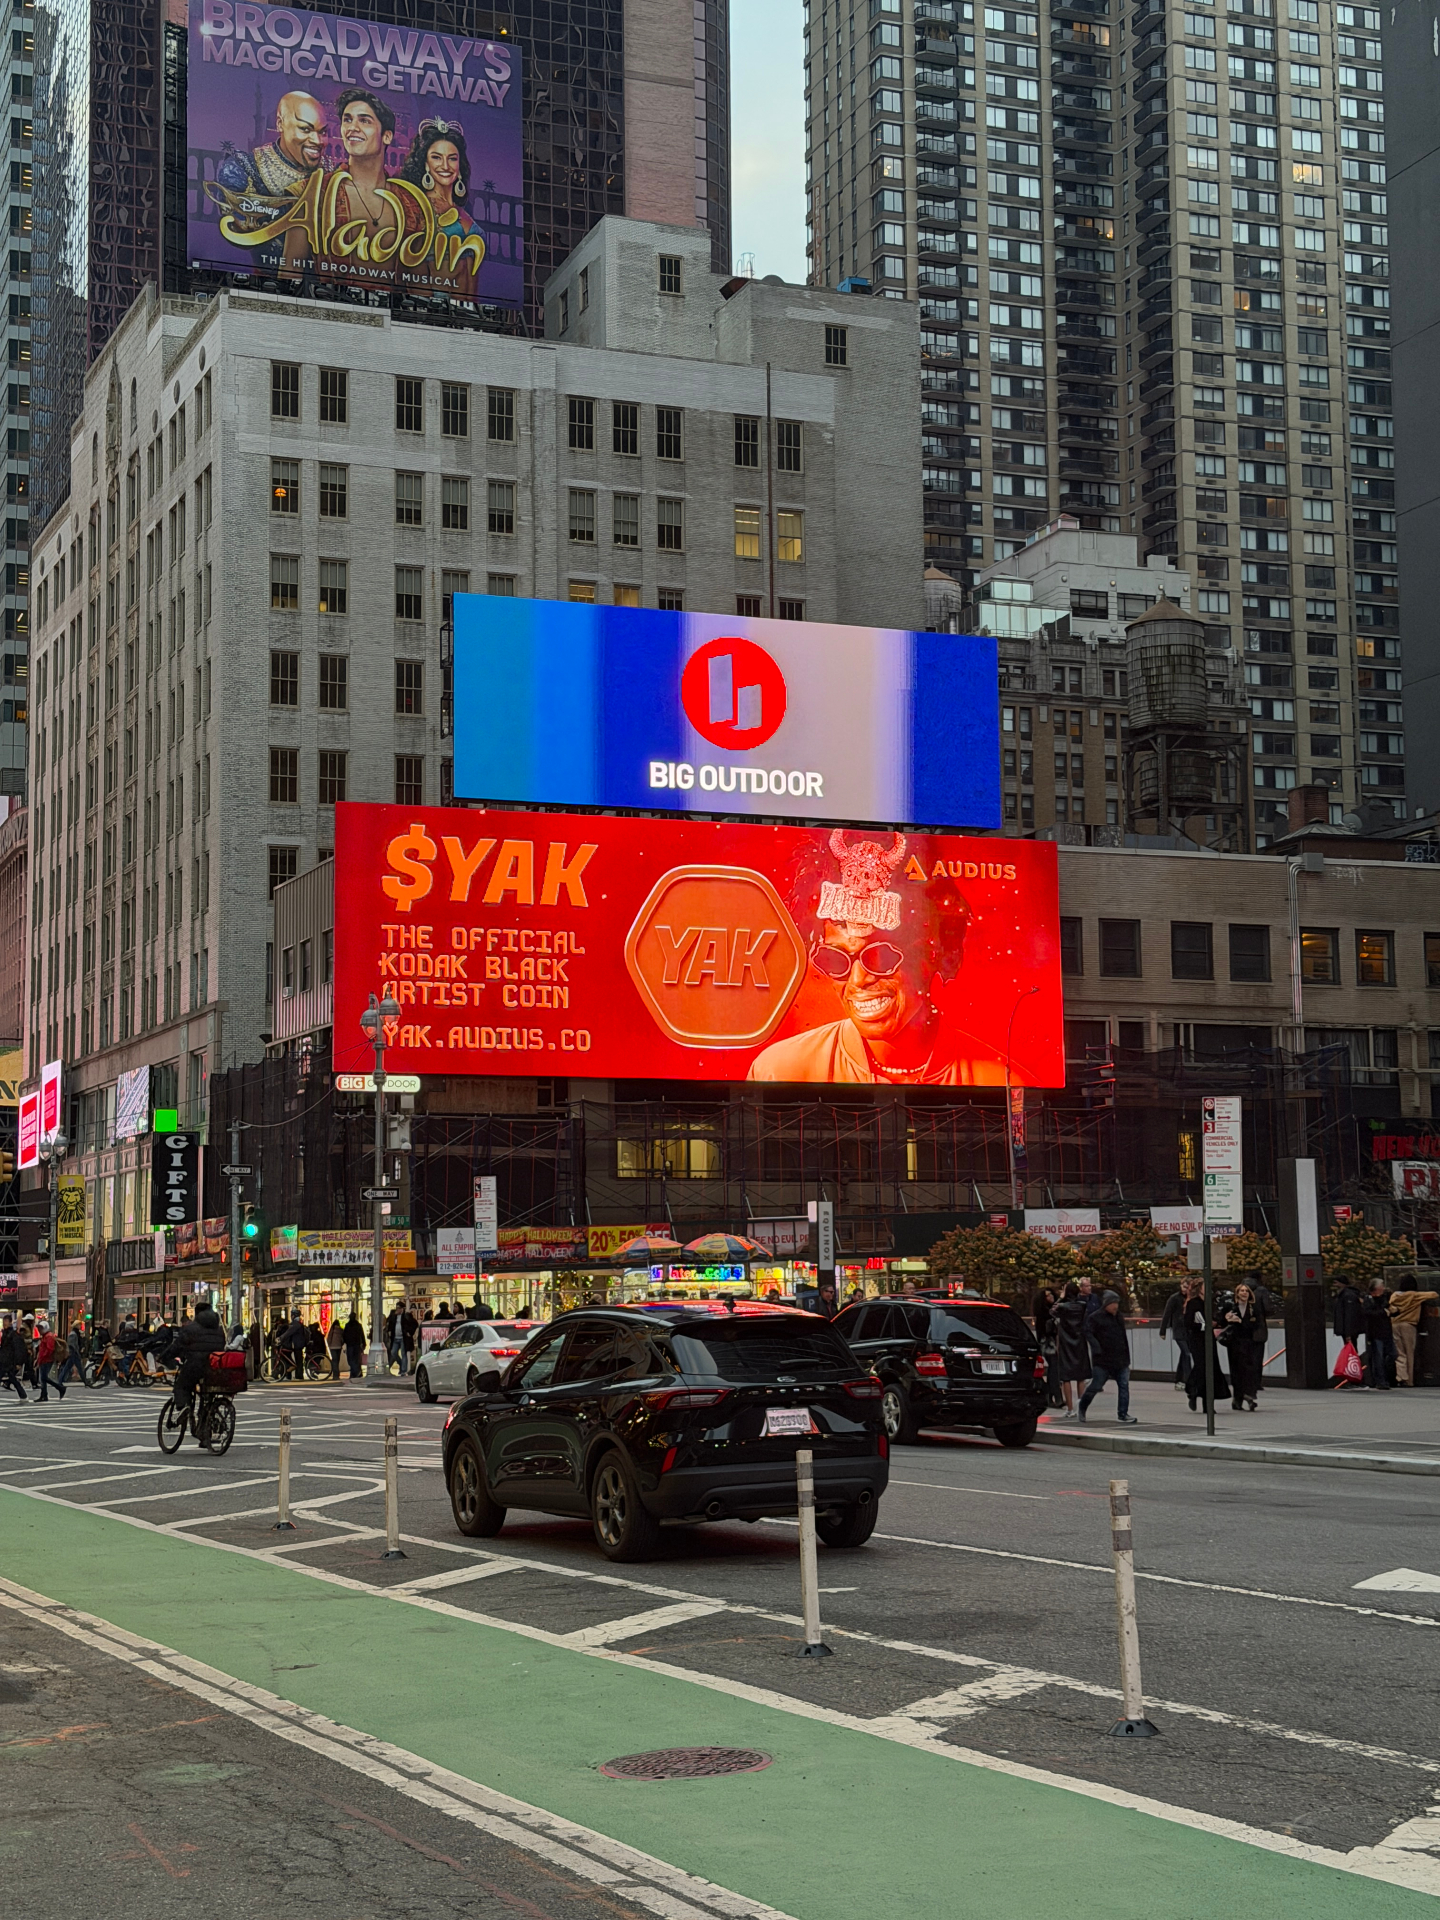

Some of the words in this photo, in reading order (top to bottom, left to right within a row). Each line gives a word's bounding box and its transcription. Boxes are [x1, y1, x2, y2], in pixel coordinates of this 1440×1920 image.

[202, 0, 512, 82] BROADWAY'S
[202, 35, 356, 84] MAGICAL
[362, 61, 511, 108] GETAWAY
[219, 168, 486, 276] Aladdin
[260, 254, 286, 267] THE
[292, 257, 315, 269] HIT
[321, 261, 396, 281] BROADWAY
[402, 272, 460, 288] MUSICAL
[649, 761, 695, 790] BIG
[699, 764, 824, 798] OUTDOOR
[381, 824, 599, 912] $YAK
[931, 859, 1017, 881] AUDIUS
[380, 923, 434, 950] THE
[451, 926, 586, 955] OFFICIAL
[380, 952, 468, 979] KODAK
[485, 956, 569, 982] BLACK
[654, 924, 779, 988] YAK
[382, 980, 485, 1007] ARTIST
[502, 985, 569, 1009] COIN
[382, 1024, 591, 1052] YAK.AUDIUS.CO
[341, 1077, 364, 1089] BIG
[367, 1079, 417, 1088] ODOOR
[1206, 1122, 1213, 1133] 3
[1372, 1135, 1415, 1162] NEW
[165, 1135, 190, 1221] GIFTS
[1206, 1175, 1214, 1185] 6
[397, 1216, 405, 1226] 50
[1028, 1225, 1044, 1234] SEE
[1045, 1225, 1057, 1234] NO
[1058, 1225, 1074, 1234] EVIL
[1075, 1224, 1097, 1233] PIZZA
[1155, 1222, 1169, 1231] SEE
[1170, 1222, 1181, 1231] NO
[1182, 1222, 1197, 1231] EVIL
[442, 1244, 455, 1252] ALL
[455, 1243, 476, 1252] EMPIR
[499, 1231, 524, 1242] HAPPY
[528, 1230, 572, 1241] HALLOWEEN
[590, 1230, 616, 1253] 20%
[421, 1327, 449, 1342] CHICAGO
